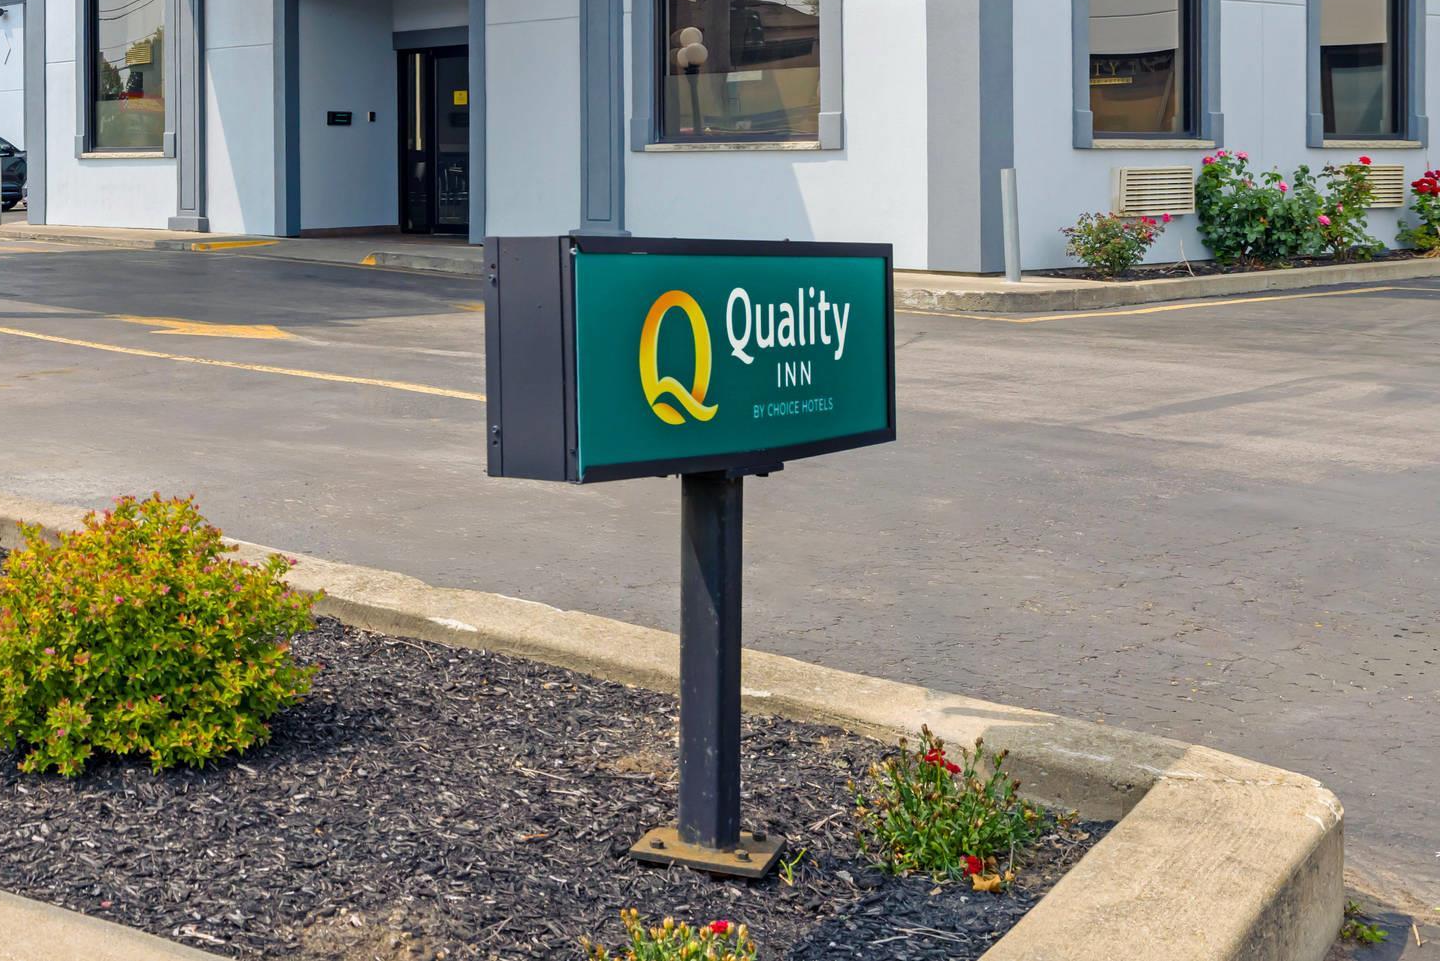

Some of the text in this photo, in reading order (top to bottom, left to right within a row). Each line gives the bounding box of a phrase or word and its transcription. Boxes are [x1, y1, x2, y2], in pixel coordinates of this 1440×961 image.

[726, 287, 850, 364] Quality
[639, 289, 719, 426] Q
[777, 360, 812, 389] INN
[753, 397, 834, 418] BY CHOICE HOTELS
